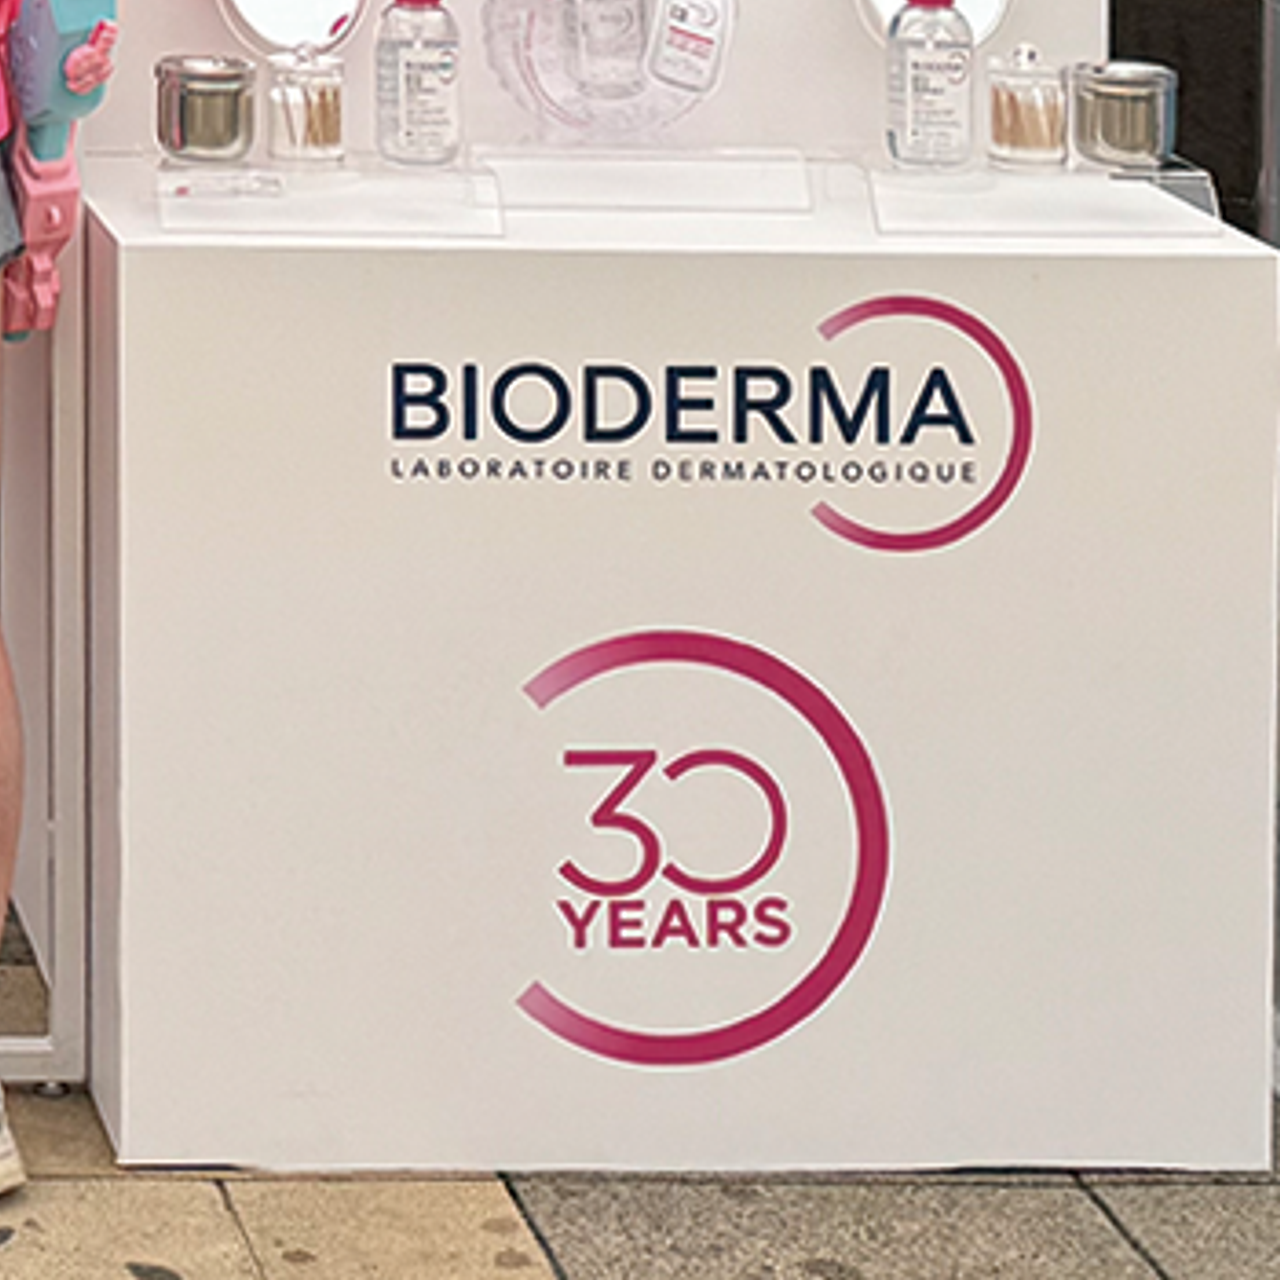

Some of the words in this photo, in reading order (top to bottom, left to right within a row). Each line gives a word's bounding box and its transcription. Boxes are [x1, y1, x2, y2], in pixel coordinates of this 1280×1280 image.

[391, 361, 976, 446] BIODERMA
[390, 456, 634, 483] LABORATOIRE
[653, 458, 978, 486] DERMATOLOGIQUE
[558, 748, 789, 898] 30
[557, 897, 793, 950] YEARS
